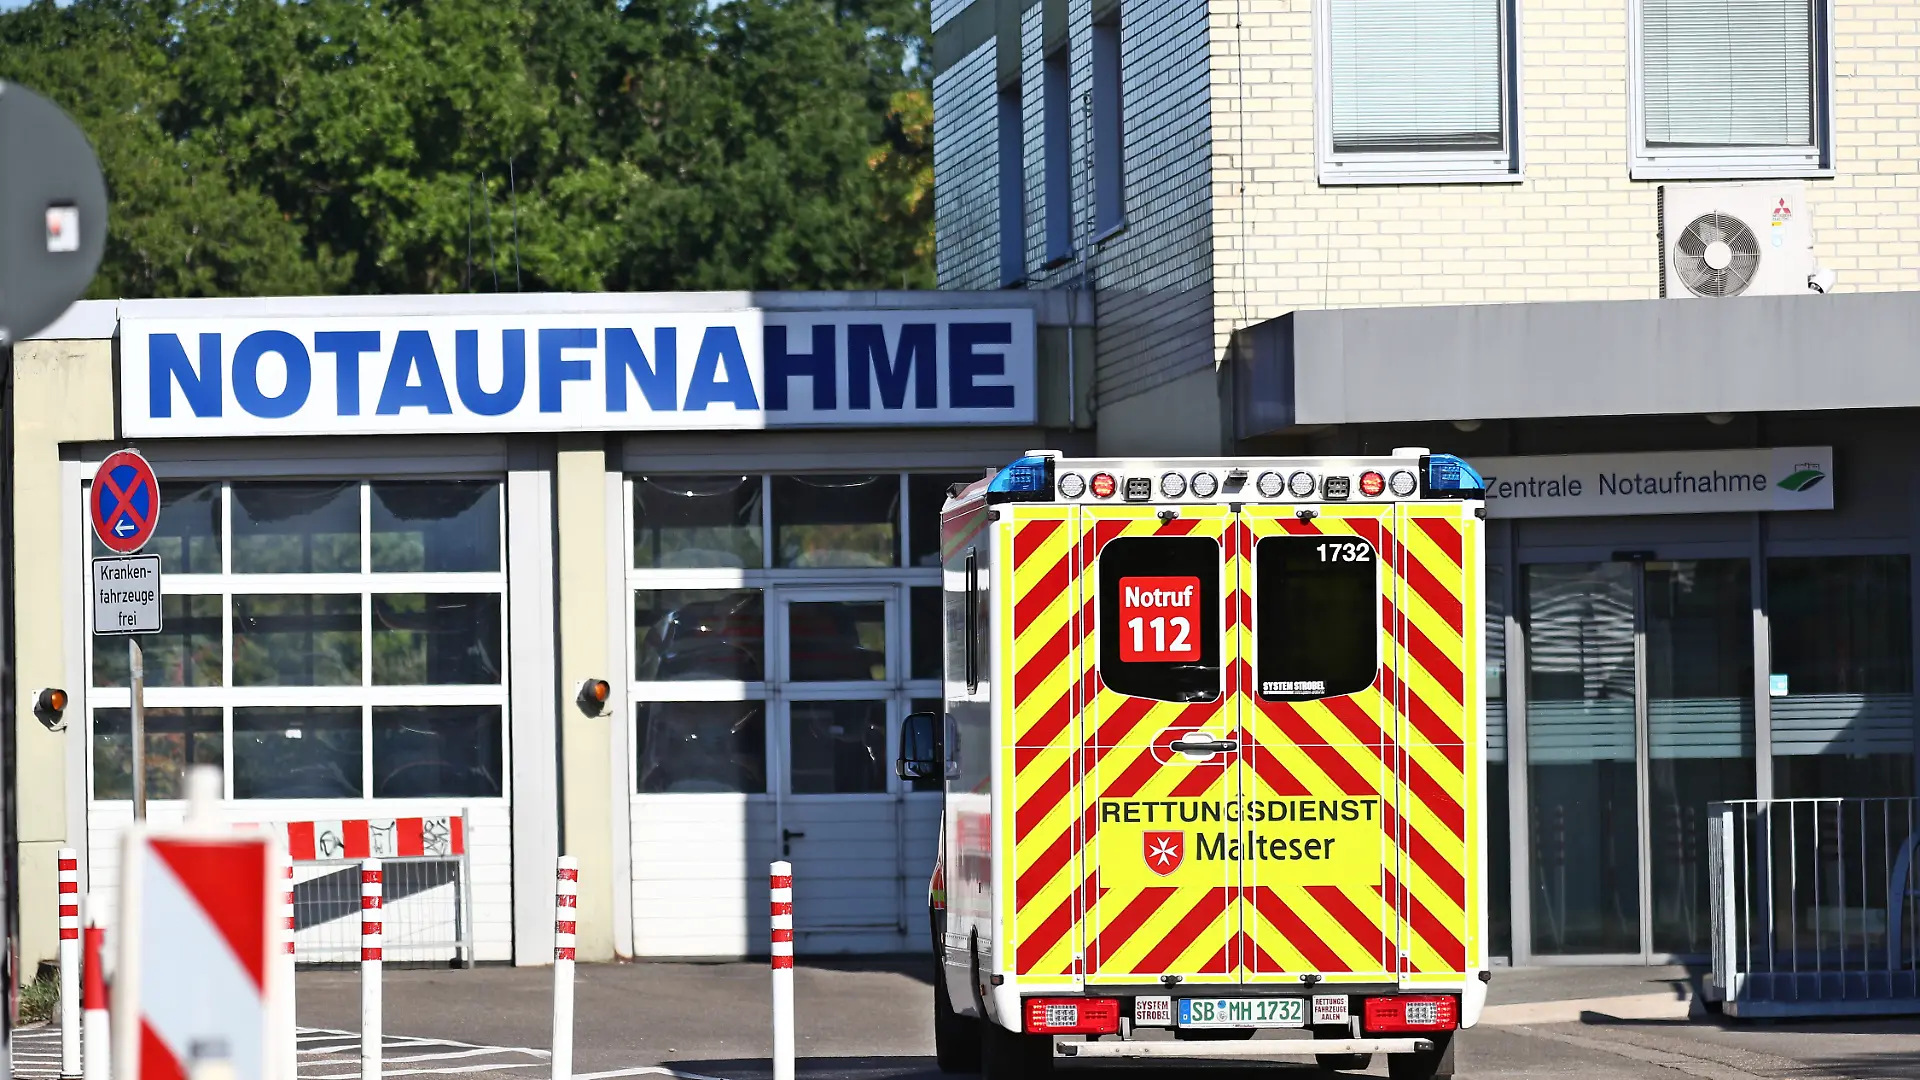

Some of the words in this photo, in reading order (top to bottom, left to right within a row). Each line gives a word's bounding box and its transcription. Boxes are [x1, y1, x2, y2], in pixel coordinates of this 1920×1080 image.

[148, 322, 1015, 418] NOTAUFNAHME
[1482, 475, 1582, 499] Zentrale
[1599, 470, 1767, 496] Notaufnahme
[1316, 543, 1370, 562] 1732
[100, 565, 152, 580] Kranken-
[99, 588, 154, 604] fahrzeuge
[1125, 585, 1193, 608] Notruf
[118, 610, 137, 626] frei
[1127, 617, 1192, 652] 112
[1262, 681, 1293, 691] SYSTEM
[1293, 680, 1325, 691] STROBEL
[1101, 799, 1378, 823] RETTUNGSDIENST
[1196, 830, 1335, 861] Malteser
[1136, 1000, 1169, 1010] SYSTEM
[1192, 1001, 1215, 1022] SB
[1229, 1001, 1252, 1021] MH
[1256, 1001, 1301, 1021] 1732
[1136, 1010, 1170, 1020] STROBEL
[1321, 1013, 1341, 1021] AALEN
